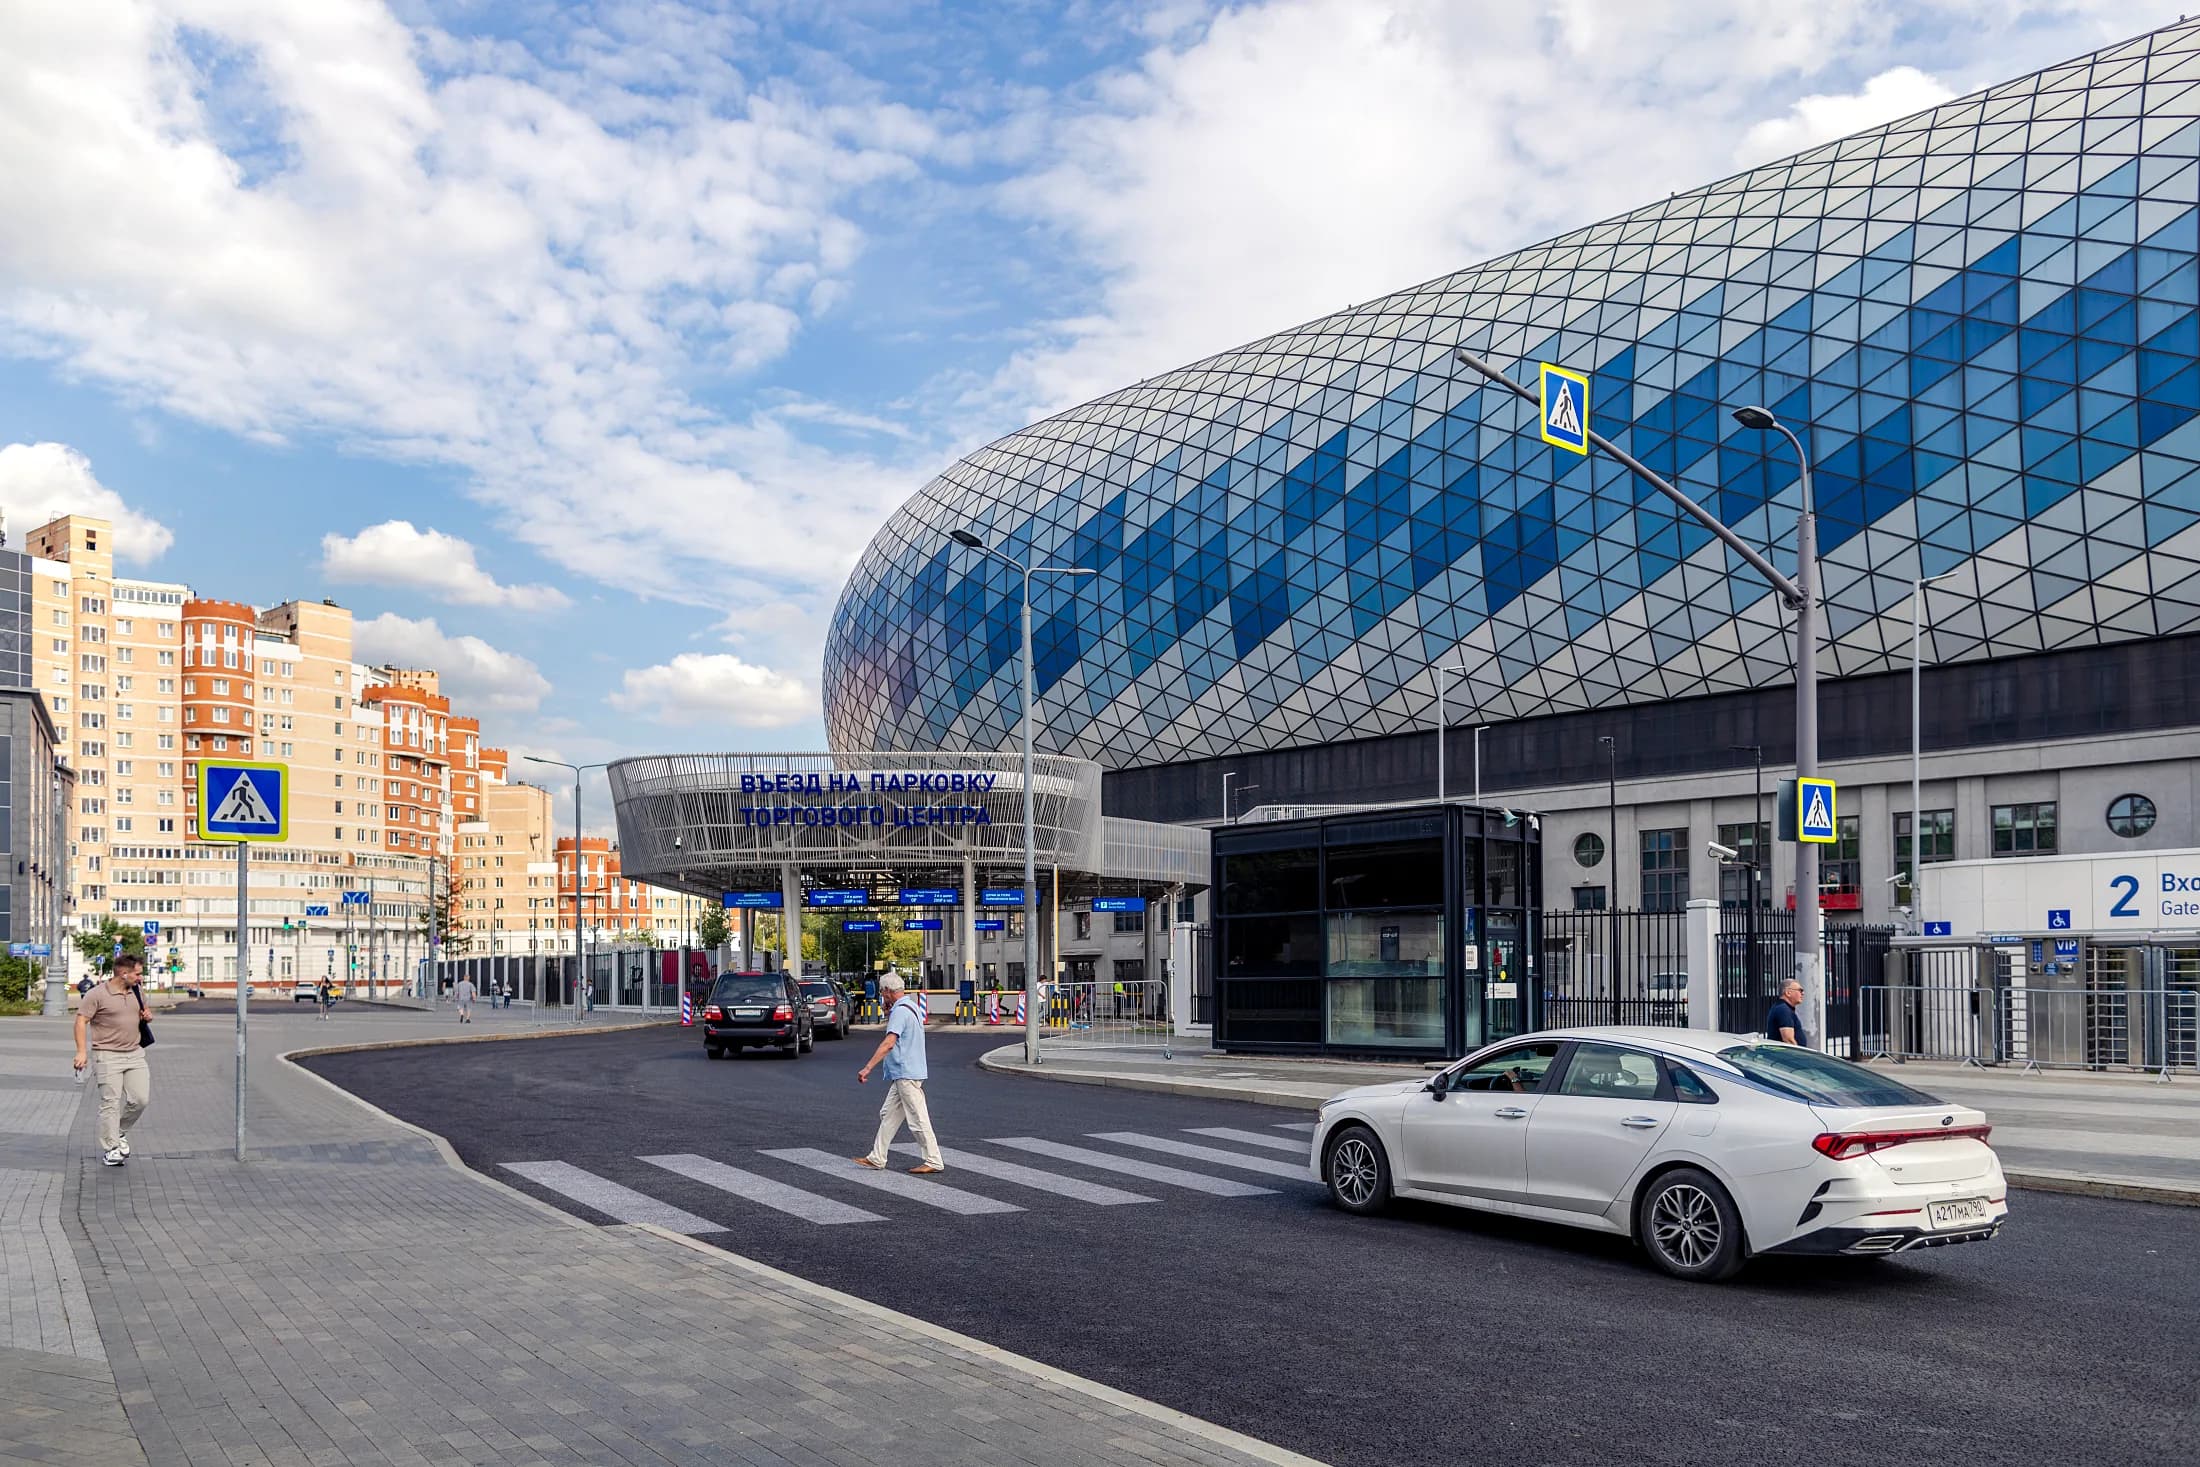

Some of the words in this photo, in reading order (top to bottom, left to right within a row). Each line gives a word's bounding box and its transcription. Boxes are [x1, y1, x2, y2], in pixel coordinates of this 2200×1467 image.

[740, 774, 822, 796] ВЪЕЗД
[829, 774, 861, 793] НА
[871, 774, 997, 793] ПАРКОВКУ
[739, 807, 885, 827] ТОРГОВОГО
[893, 806, 992, 829] ЦЕНТРА
[2110, 874, 2140, 917] 2
[2161, 900, 2200, 916] Gate
[2056, 939, 2077, 951] VIP
